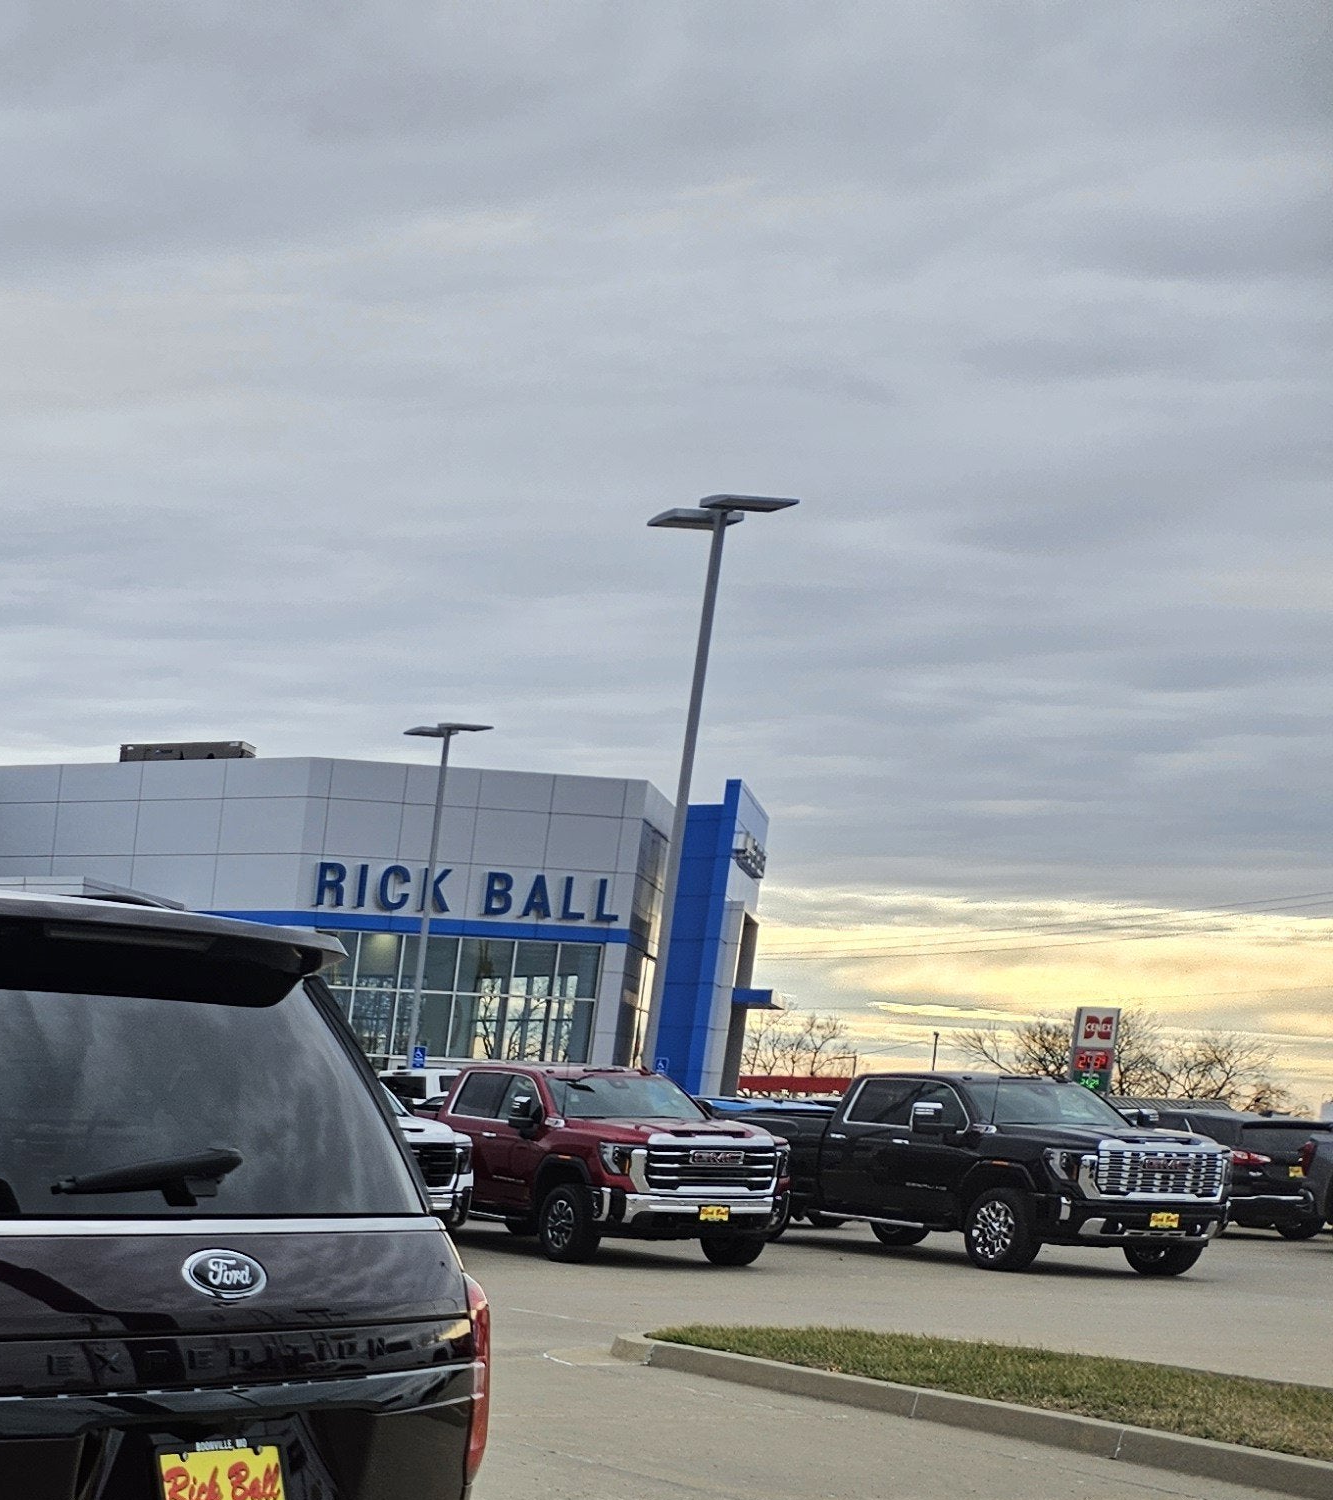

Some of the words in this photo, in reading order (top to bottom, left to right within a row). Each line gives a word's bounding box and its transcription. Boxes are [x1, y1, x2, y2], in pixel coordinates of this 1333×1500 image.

[315, 861, 453, 912] RICK
[483, 870, 619, 922] BALL
[208, 1258, 252, 1285] Ford
[47, 1337, 387, 1377] EXPEDITION
